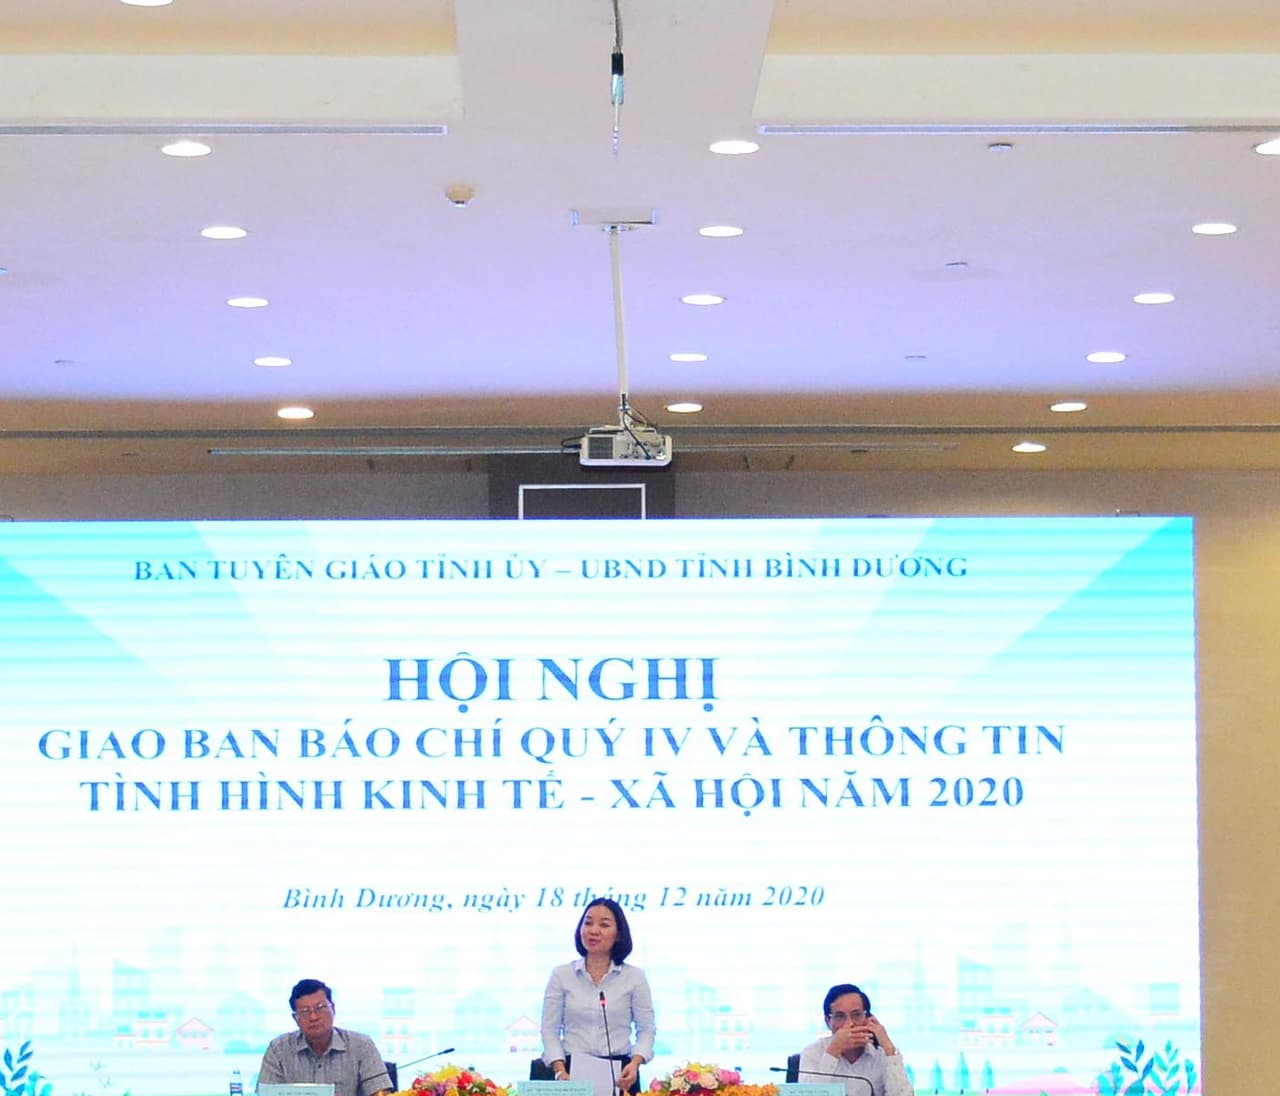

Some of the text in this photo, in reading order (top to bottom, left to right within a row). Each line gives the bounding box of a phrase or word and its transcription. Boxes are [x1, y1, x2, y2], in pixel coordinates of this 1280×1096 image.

[135, 561, 198, 581] BAN
[209, 554, 315, 581] TUYÊN
[326, 554, 408, 580] GIÁO
[416, 553, 493, 580] TỈNH
[506, 553, 546, 580] ỦY
[581, 560, 668, 580] UBND
[676, 553, 754, 579] TỈNH
[766, 552, 841, 579] BÌNH
[853, 554, 968, 579] DƯƠNG
[384, 652, 721, 714] HỘI NGHỊ
[38, 715, 1065, 766] GIAO BAN BÁO CHÍ QUÝ IV VÀ THÔNG TIN
[80, 772, 201, 813] TÌNH
[220, 772, 345, 812] HÌNH
[362, 780, 488, 812] KINH
[503, 770, 565, 811] TẾ
[611, 772, 678, 810] XÃ
[694, 774, 784, 818] HỘI
[800, 770, 912, 810] NĂM
[929, 777, 1026, 809] 2020
[283, 888, 345, 909] Bình
[356, 888, 454, 913] Dương,
[463, 887, 527, 913] ngày
[537, 887, 565, 908] 18
[659, 887, 689, 907] 12
[696, 887, 753, 907] năm
[762, 886, 826, 907] 2020
